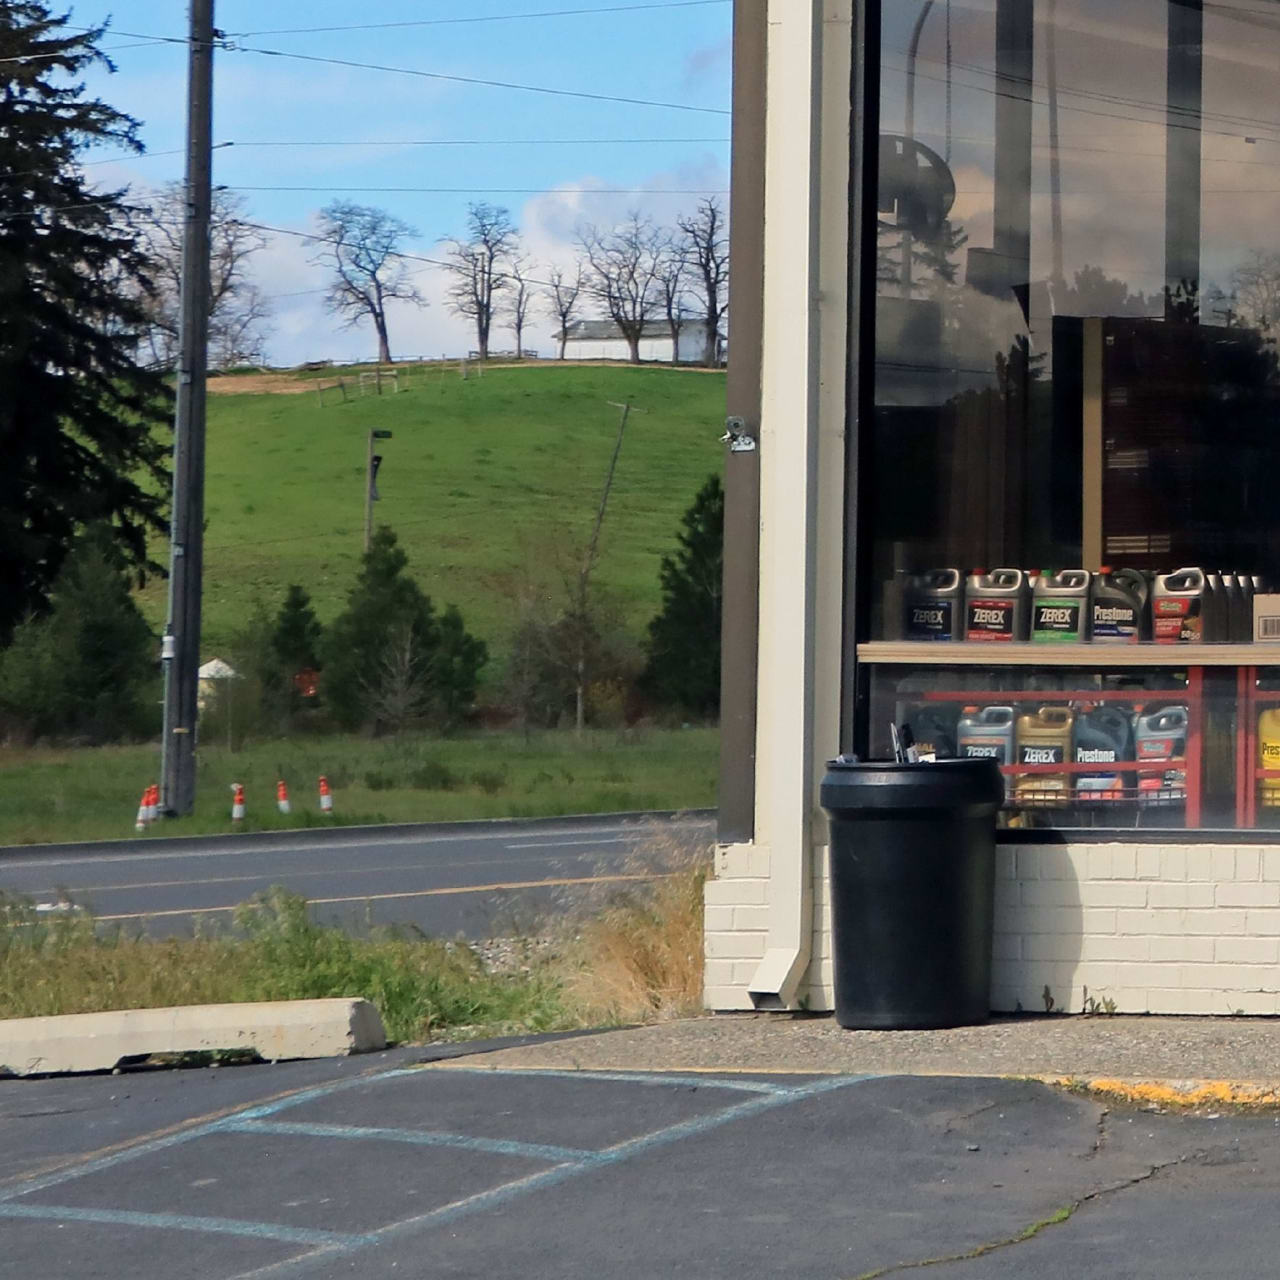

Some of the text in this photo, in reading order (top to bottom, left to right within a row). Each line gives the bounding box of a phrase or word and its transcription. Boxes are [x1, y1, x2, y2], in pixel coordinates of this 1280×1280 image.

[913, 609, 944, 623] ZEREX
[973, 608, 1005, 623] ZEREX
[1040, 608, 1072, 622] ZEREX
[1094, 605, 1133, 620] Prestone
[1024, 747, 1055, 763] ZEREX
[1077, 747, 1116, 762] Prestone
